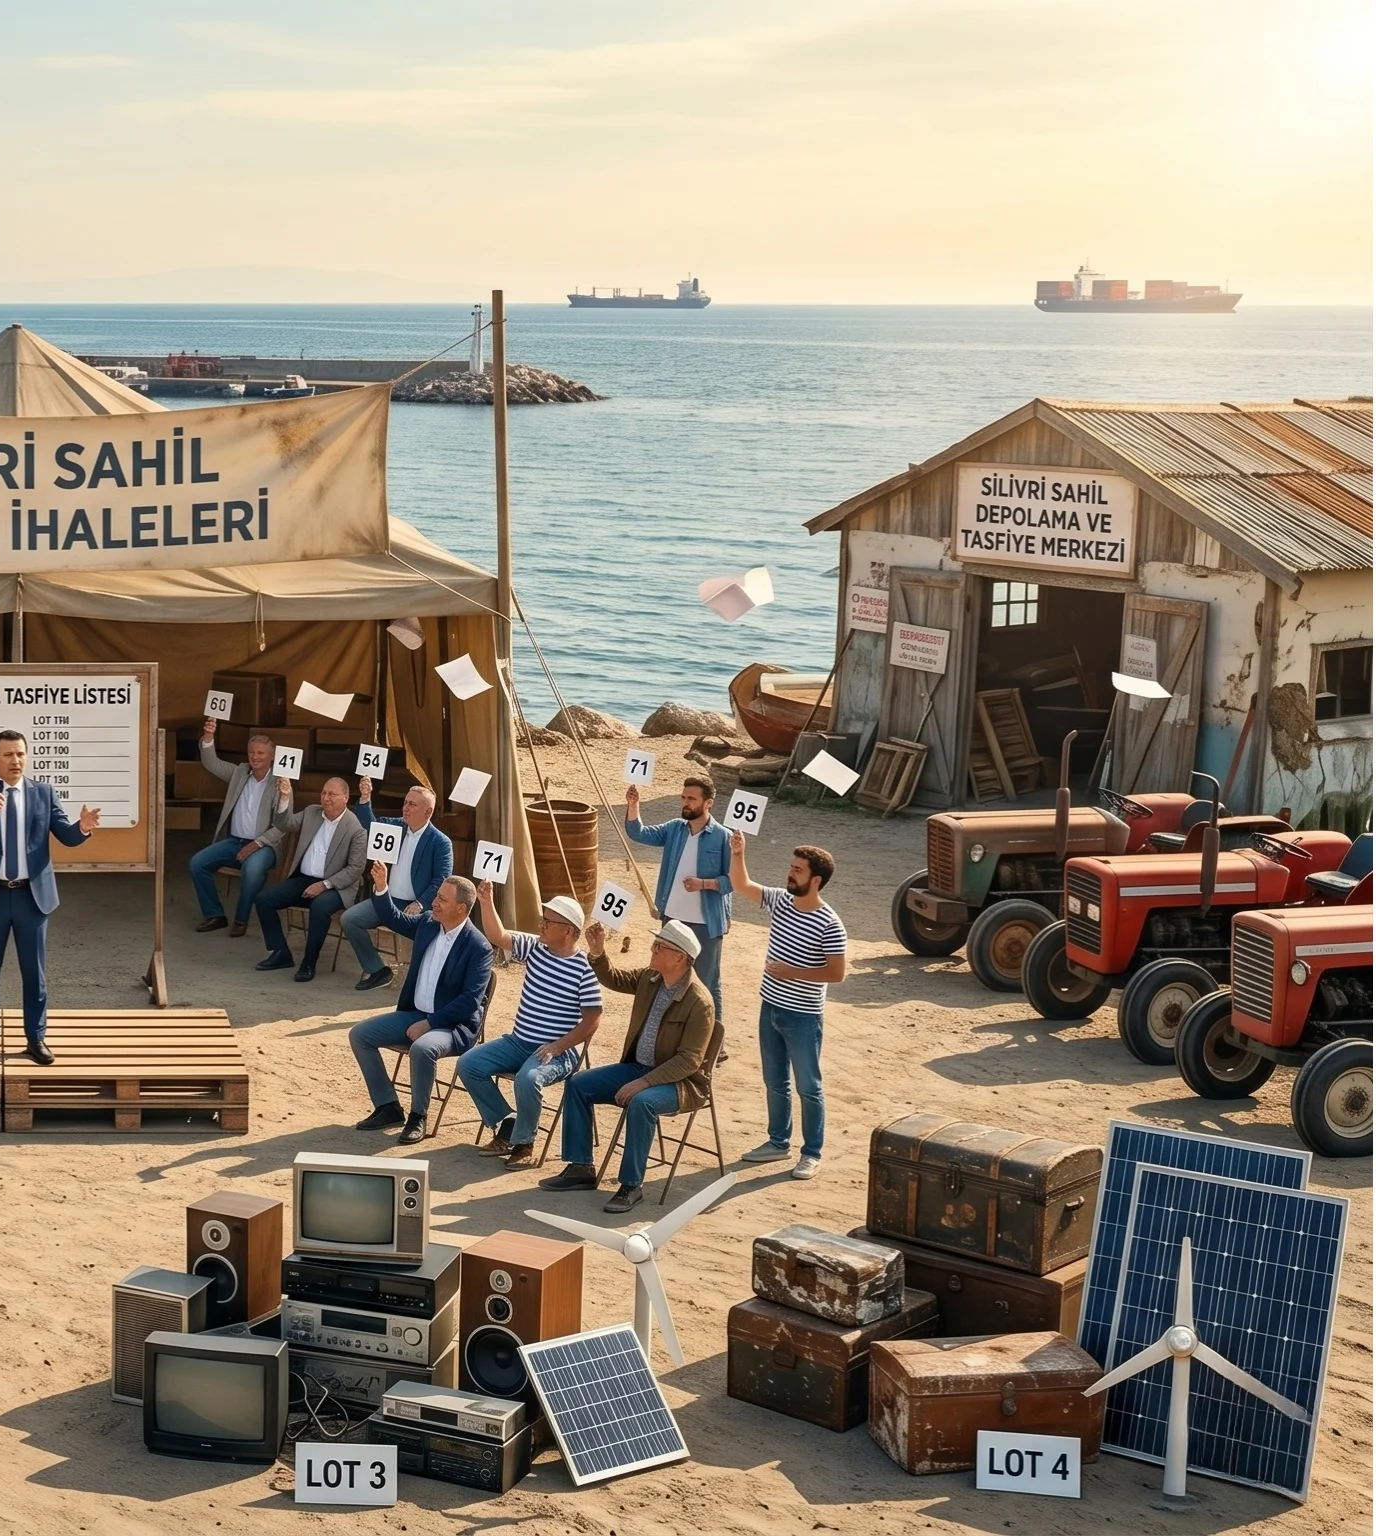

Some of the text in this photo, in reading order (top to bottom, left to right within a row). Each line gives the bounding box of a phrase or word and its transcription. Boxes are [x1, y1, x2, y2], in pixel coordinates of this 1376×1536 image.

[54, 427, 220, 490] SAHİL
[981, 473, 1108, 505] SİLİVRİ SAHİL
[12, 487, 269, 551] İHALELERİ
[976, 503, 1112, 533] DEPOLAMA VE
[961, 528, 1125, 563] TASFİYE MERKEZİ
[4, 683, 70, 705] TASFİYE
[74, 683, 131, 705] LİSTESİ
[210, 697, 227, 711] 60
[33, 716, 51, 725] LOT
[33, 731, 51, 740] LOT
[33, 746, 51, 755] LOT
[362, 753, 380, 768] 54
[33, 760, 51, 770] LOT
[278, 755, 296, 769] 41
[631, 758, 648, 776] 71
[732, 801, 758, 823] 95
[482, 851, 503, 873] 71
[601, 892, 627, 918] 95
[306, 1459, 386, 1490] LOT 3
[988, 1447, 1070, 1481] LOT 4
